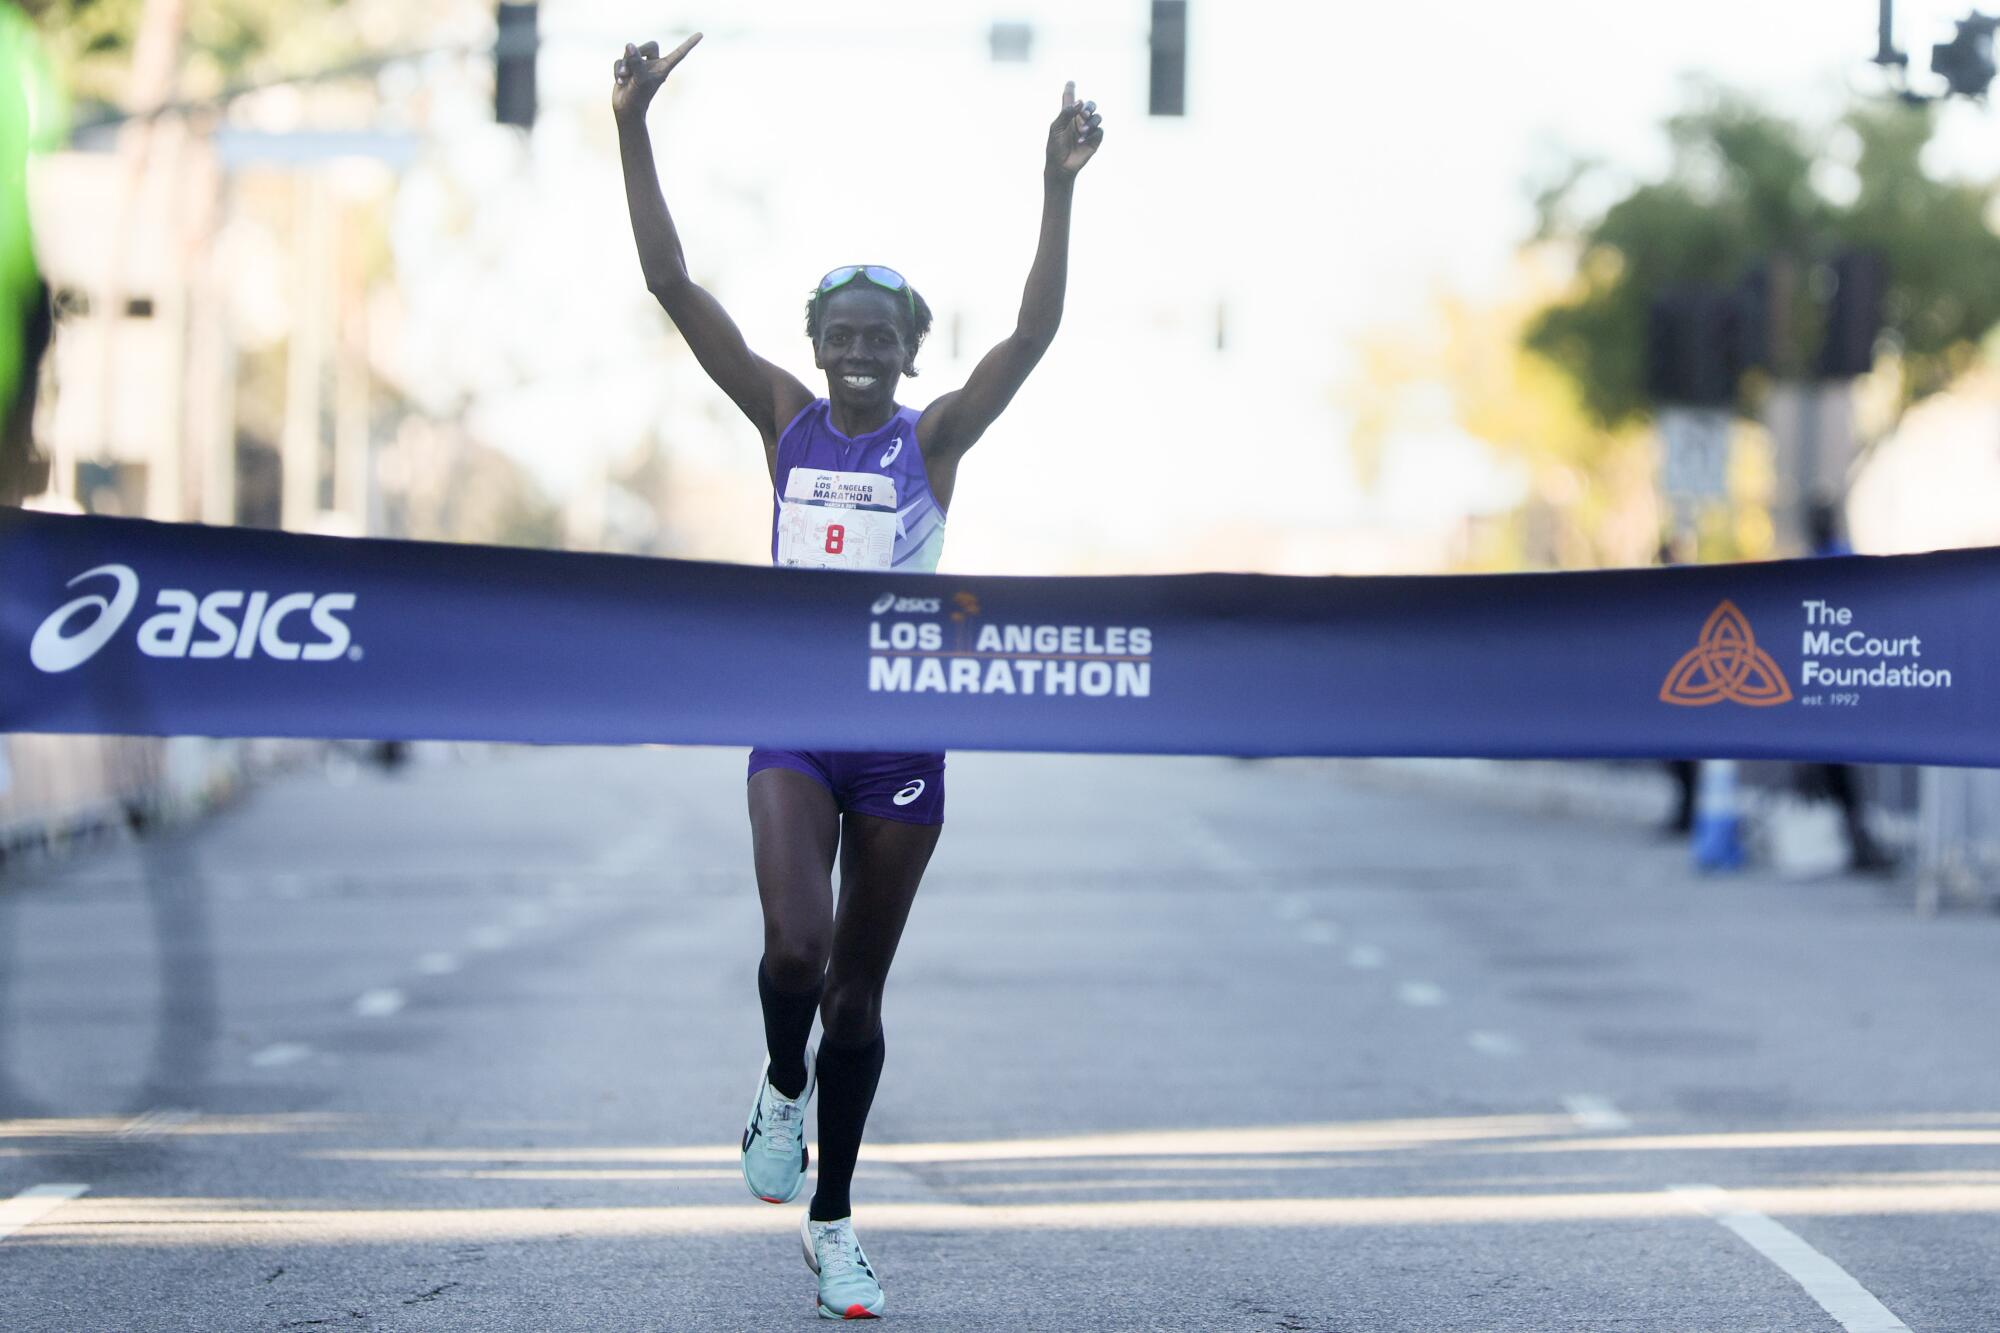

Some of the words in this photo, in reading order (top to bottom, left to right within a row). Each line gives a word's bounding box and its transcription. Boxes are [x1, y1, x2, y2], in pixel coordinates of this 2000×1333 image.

[813, 490, 872, 502] MARATHON
[838, 484, 873, 493] ANGELES
[825, 524, 845, 554] 8
[1802, 600, 1853, 625] The
[869, 621, 943, 650] LOS
[975, 624, 1152, 655] ANGELES
[1802, 631, 1921, 657] McCourt
[868, 656, 1151, 697] MARATHON
[1802, 661, 1952, 688] Foundation
[1830, 693, 1860, 706] 1992
